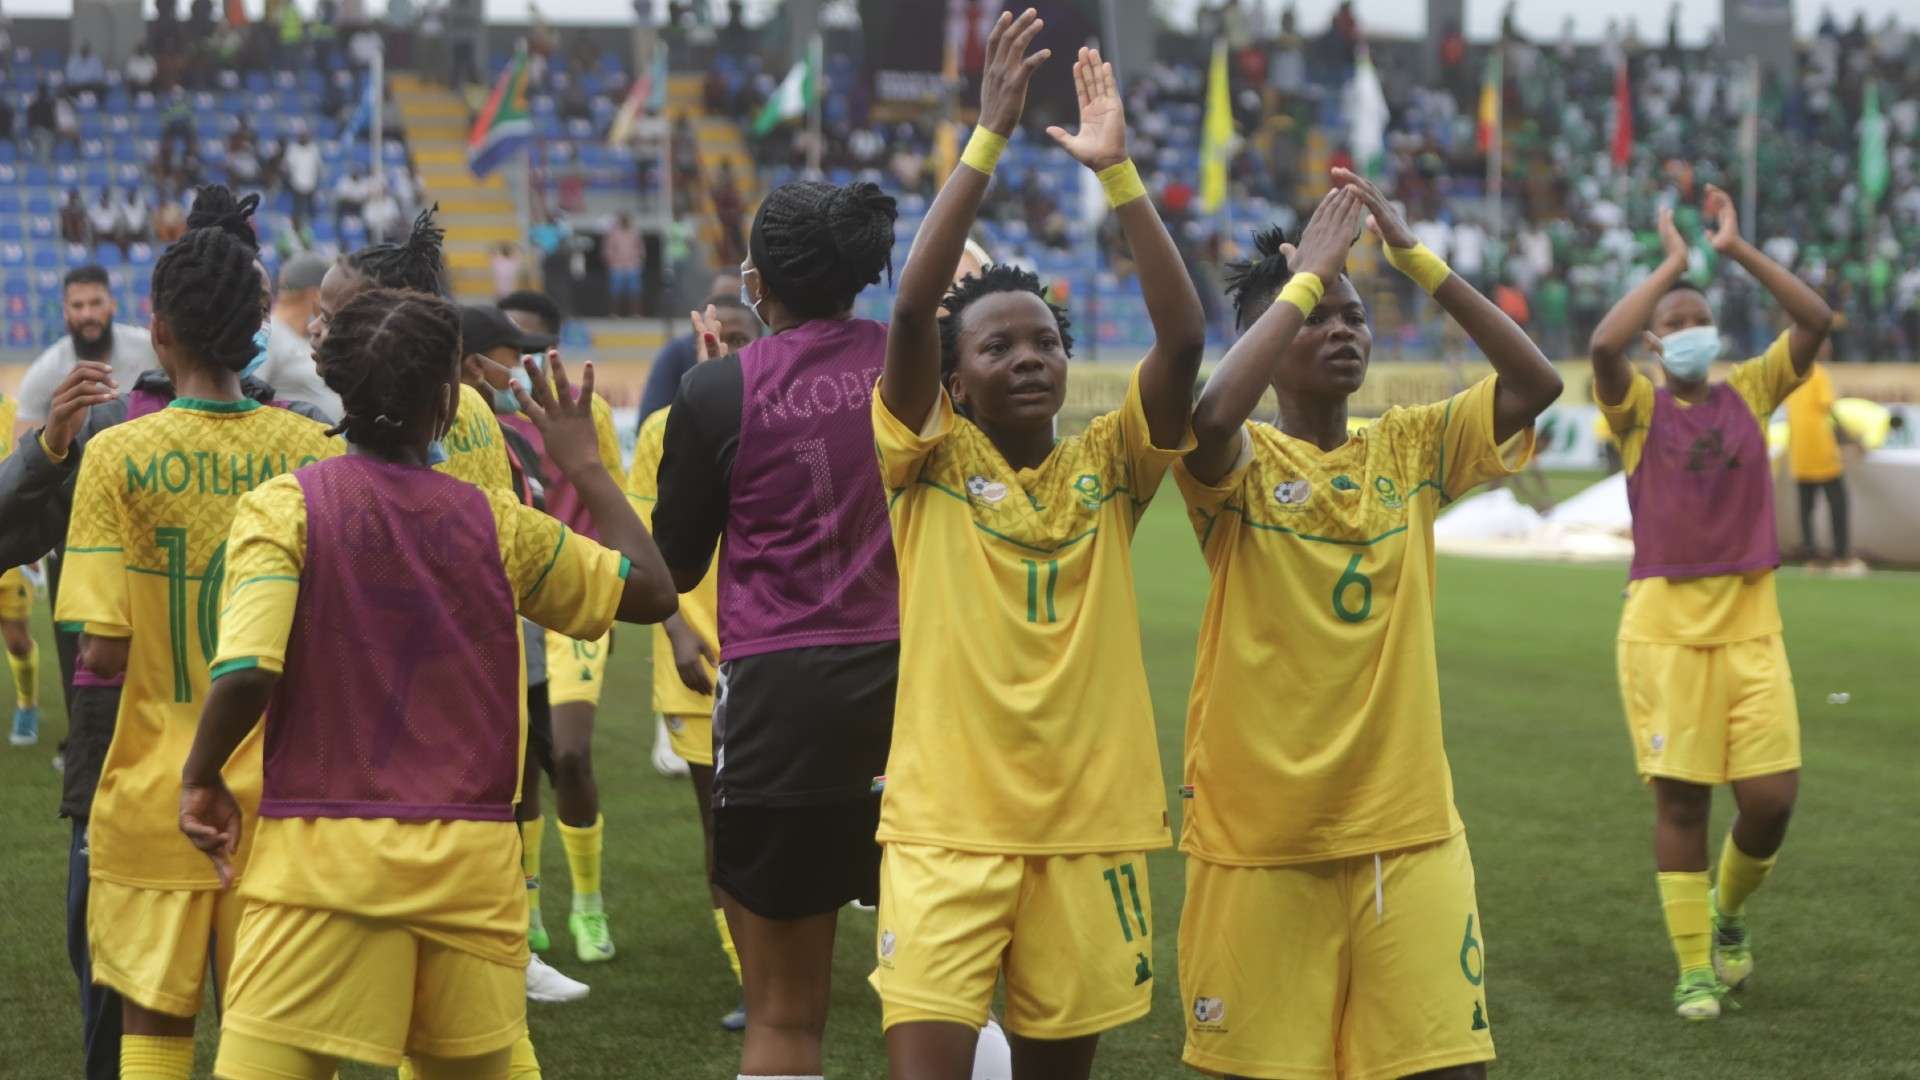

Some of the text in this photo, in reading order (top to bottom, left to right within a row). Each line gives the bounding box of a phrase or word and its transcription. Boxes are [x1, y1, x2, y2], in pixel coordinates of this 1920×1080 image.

[1021, 559, 1058, 623] 11
[1332, 554, 1372, 623] 6
[1103, 863, 1148, 943] 11
[1460, 912, 1482, 986] 6
